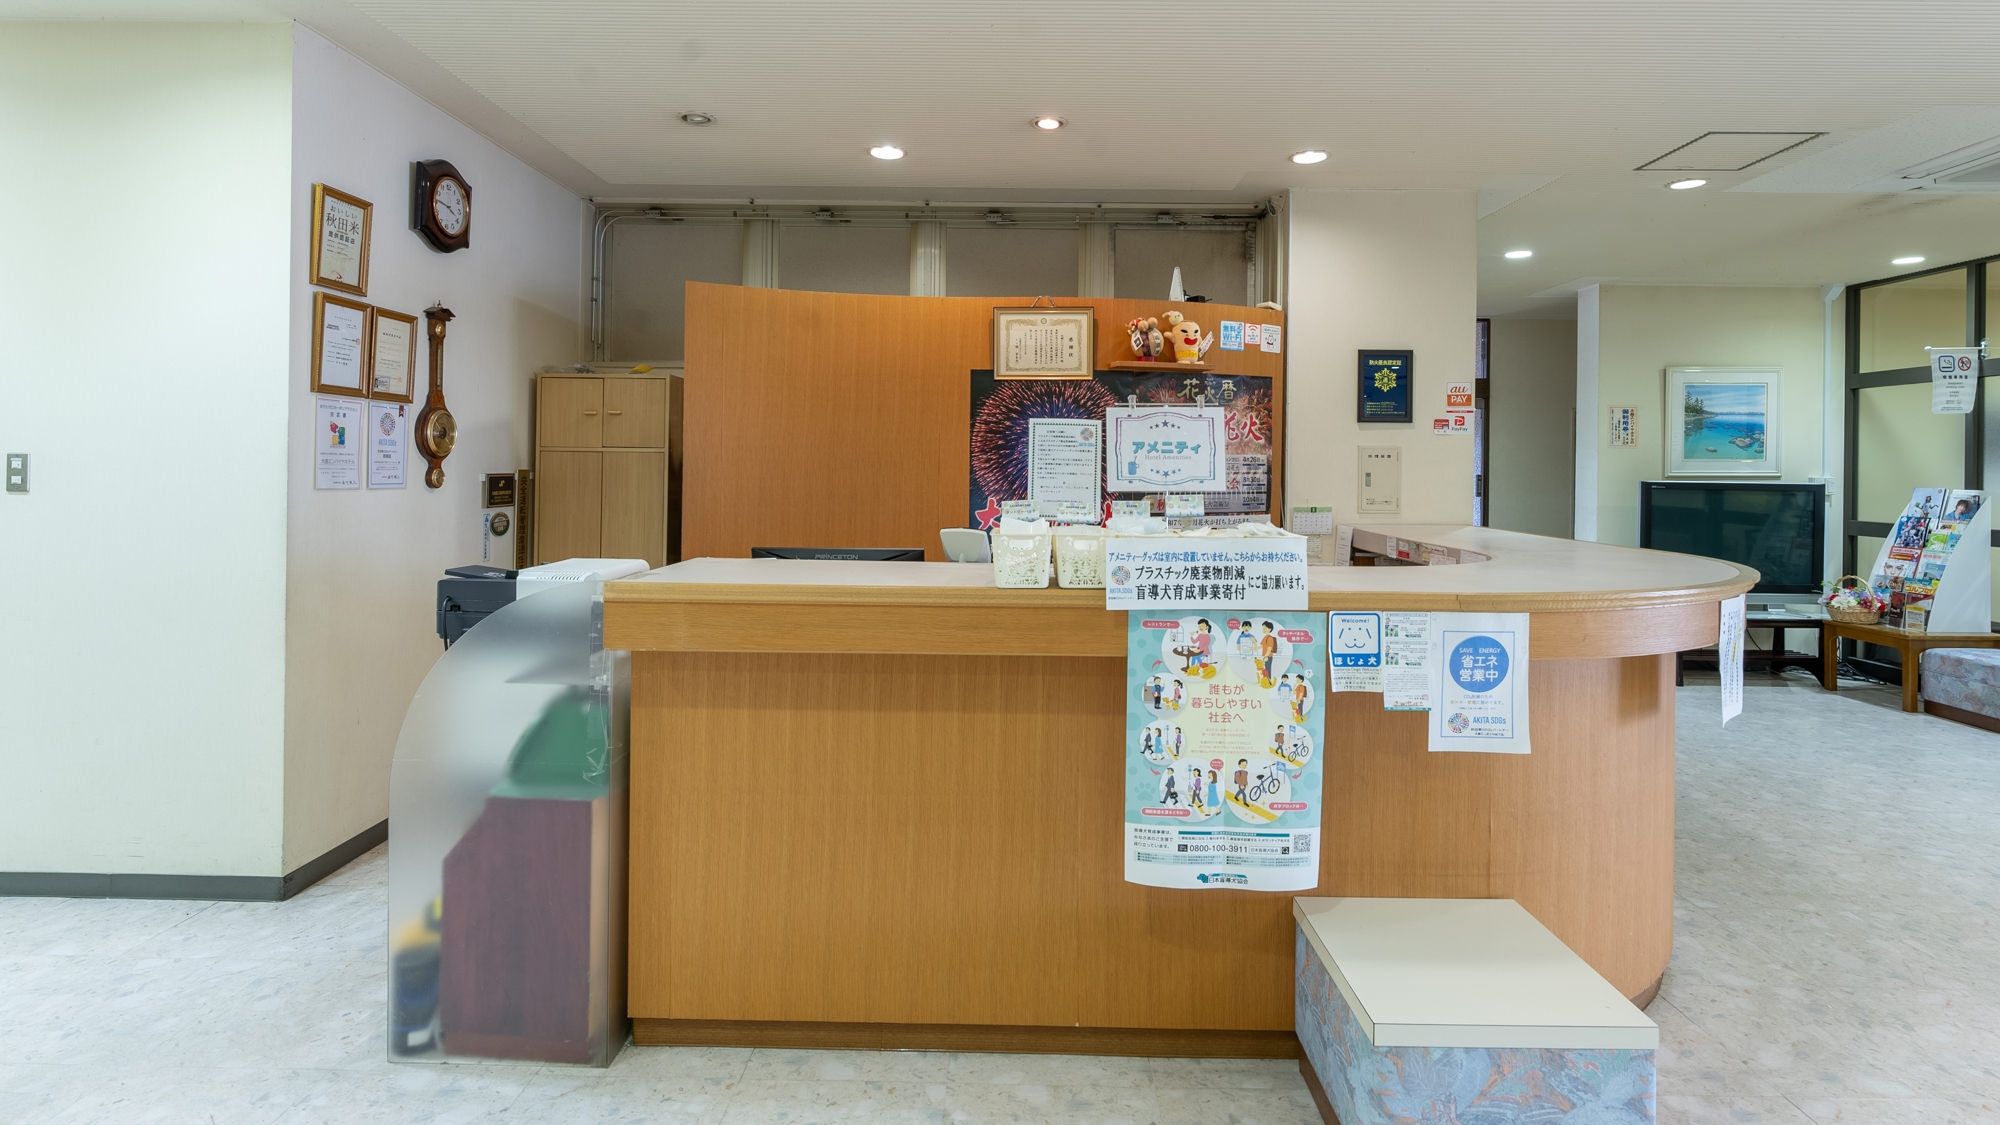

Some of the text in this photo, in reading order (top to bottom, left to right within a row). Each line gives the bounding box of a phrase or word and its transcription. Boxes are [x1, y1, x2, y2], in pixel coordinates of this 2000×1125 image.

[326, 212, 360, 236] 秋田米
[1450, 386, 1469, 394] au
[1451, 395, 1468, 404] PAY
[1132, 441, 1202, 455] アメニティ
[1135, 565, 1246, 580] プラスチック廃棄物削減
[1248, 574, 1304, 590] にご協力願います。
[1136, 583, 1247, 600] 盲導犬育成事業寄付
[1334, 656, 1377, 665] ほじょ犬
[1461, 655, 1499, 668] 省エネ
[1459, 669, 1499, 682] 営業中
[1209, 683, 1245, 696] 誰もが
[1192, 697, 1262, 710] 暮らしやすい
[1208, 711, 1245, 723] 社会へ
[1473, 716, 1507, 724] AKITA SDGs
[1189, 844, 1248, 853] 0800-100-3911
